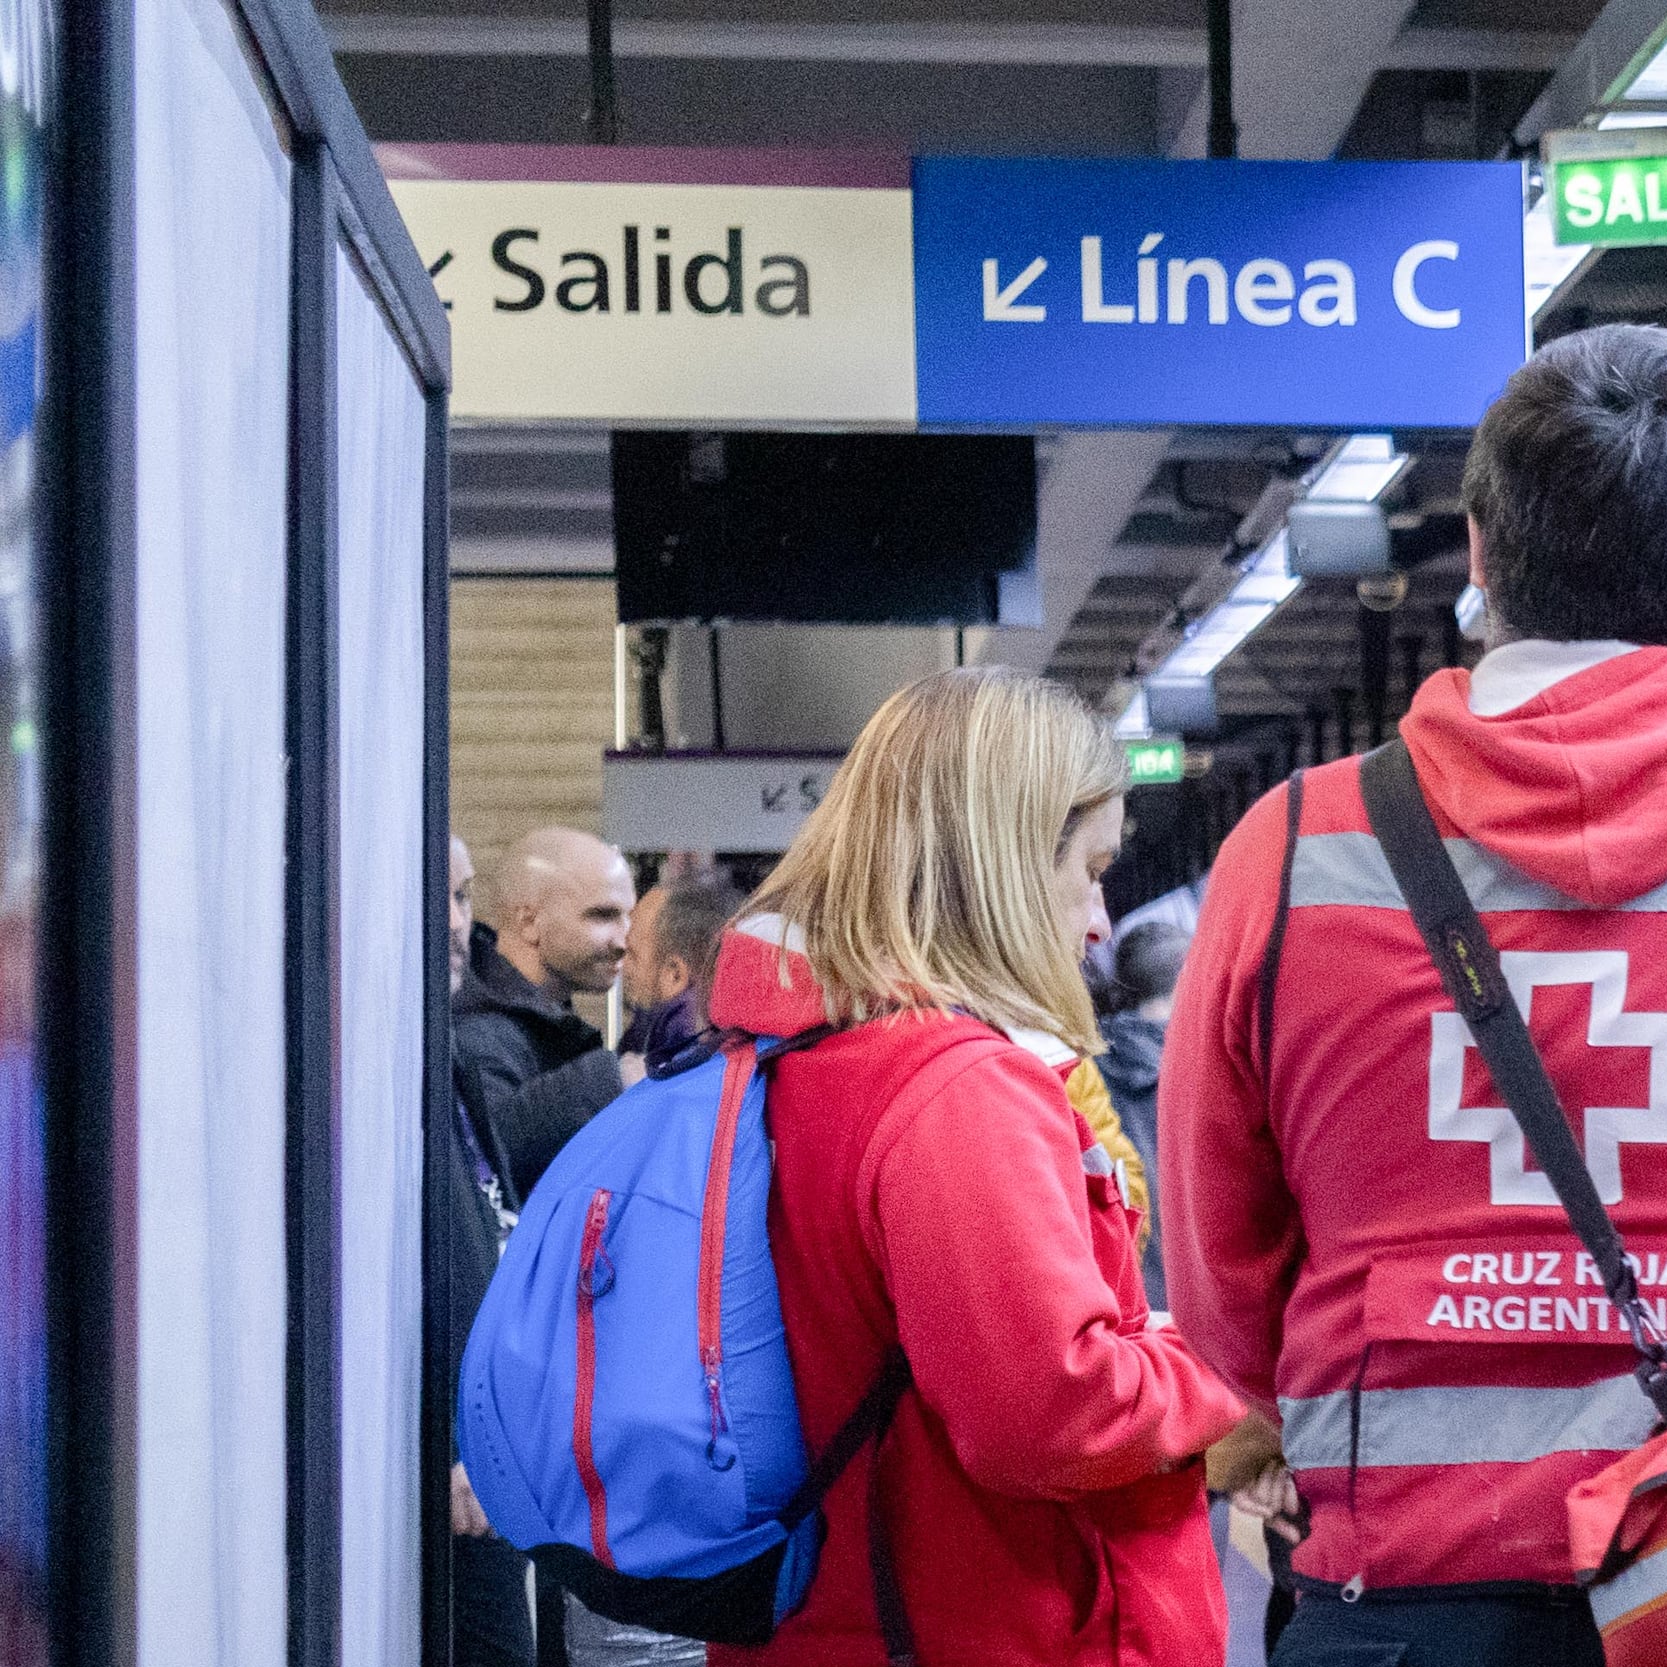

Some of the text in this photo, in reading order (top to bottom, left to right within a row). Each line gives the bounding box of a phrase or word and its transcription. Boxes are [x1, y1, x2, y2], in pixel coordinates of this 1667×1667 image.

[491, 224, 813, 317] Salida
[1080, 232, 1462, 330] Línea C
[1442, 1252, 1562, 1286] CRUZ
